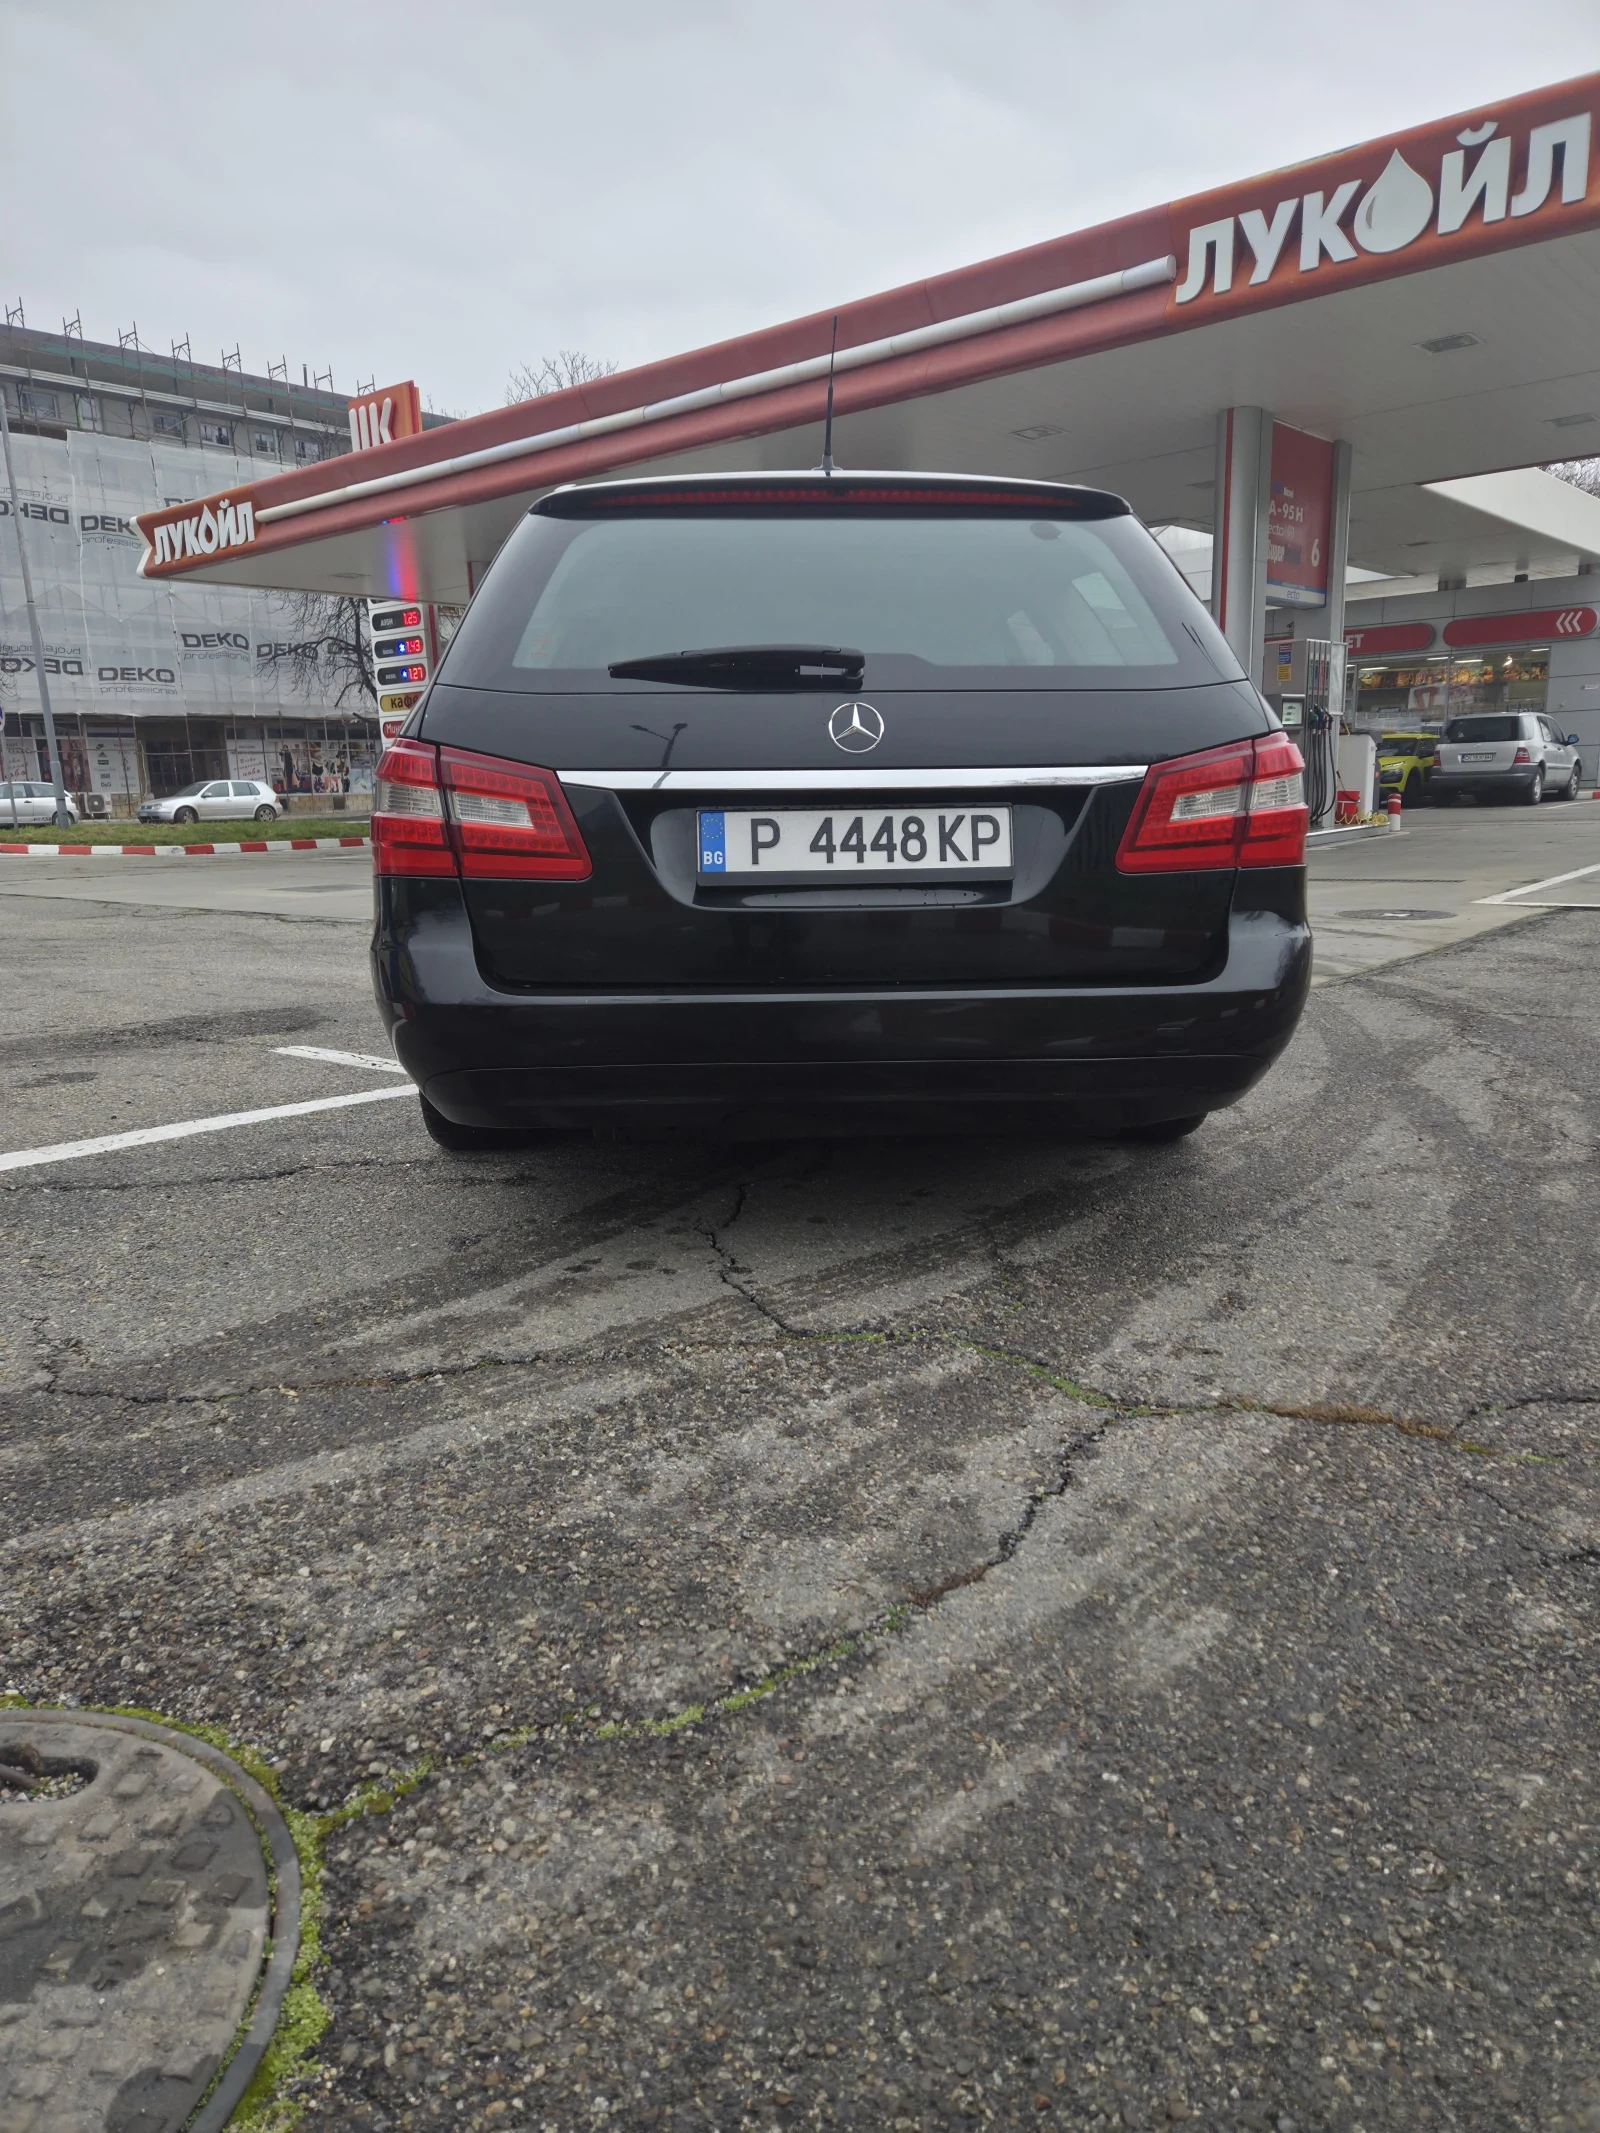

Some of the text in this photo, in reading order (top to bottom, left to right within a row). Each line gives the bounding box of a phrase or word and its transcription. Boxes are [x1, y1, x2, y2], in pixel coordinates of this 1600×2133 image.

[1175, 111, 1592, 304] ЛУКОЙЛ
[153, 499, 255, 565] ЛУКОЙЛ
[1311, 538, 1320, 567] 6
[1286, 590, 1300, 600] ecto
[402, 611, 418, 625] 1.25
[181, 632, 250, 651] DEKO
[406, 639, 421, 653] 1.43
[97, 667, 176, 684] DEKO
[408, 667, 424, 680] 1.27
[100, 684, 178, 696] professional
[750, 814, 1001, 865] P 4448 KP
[703, 851, 723, 865] BG
